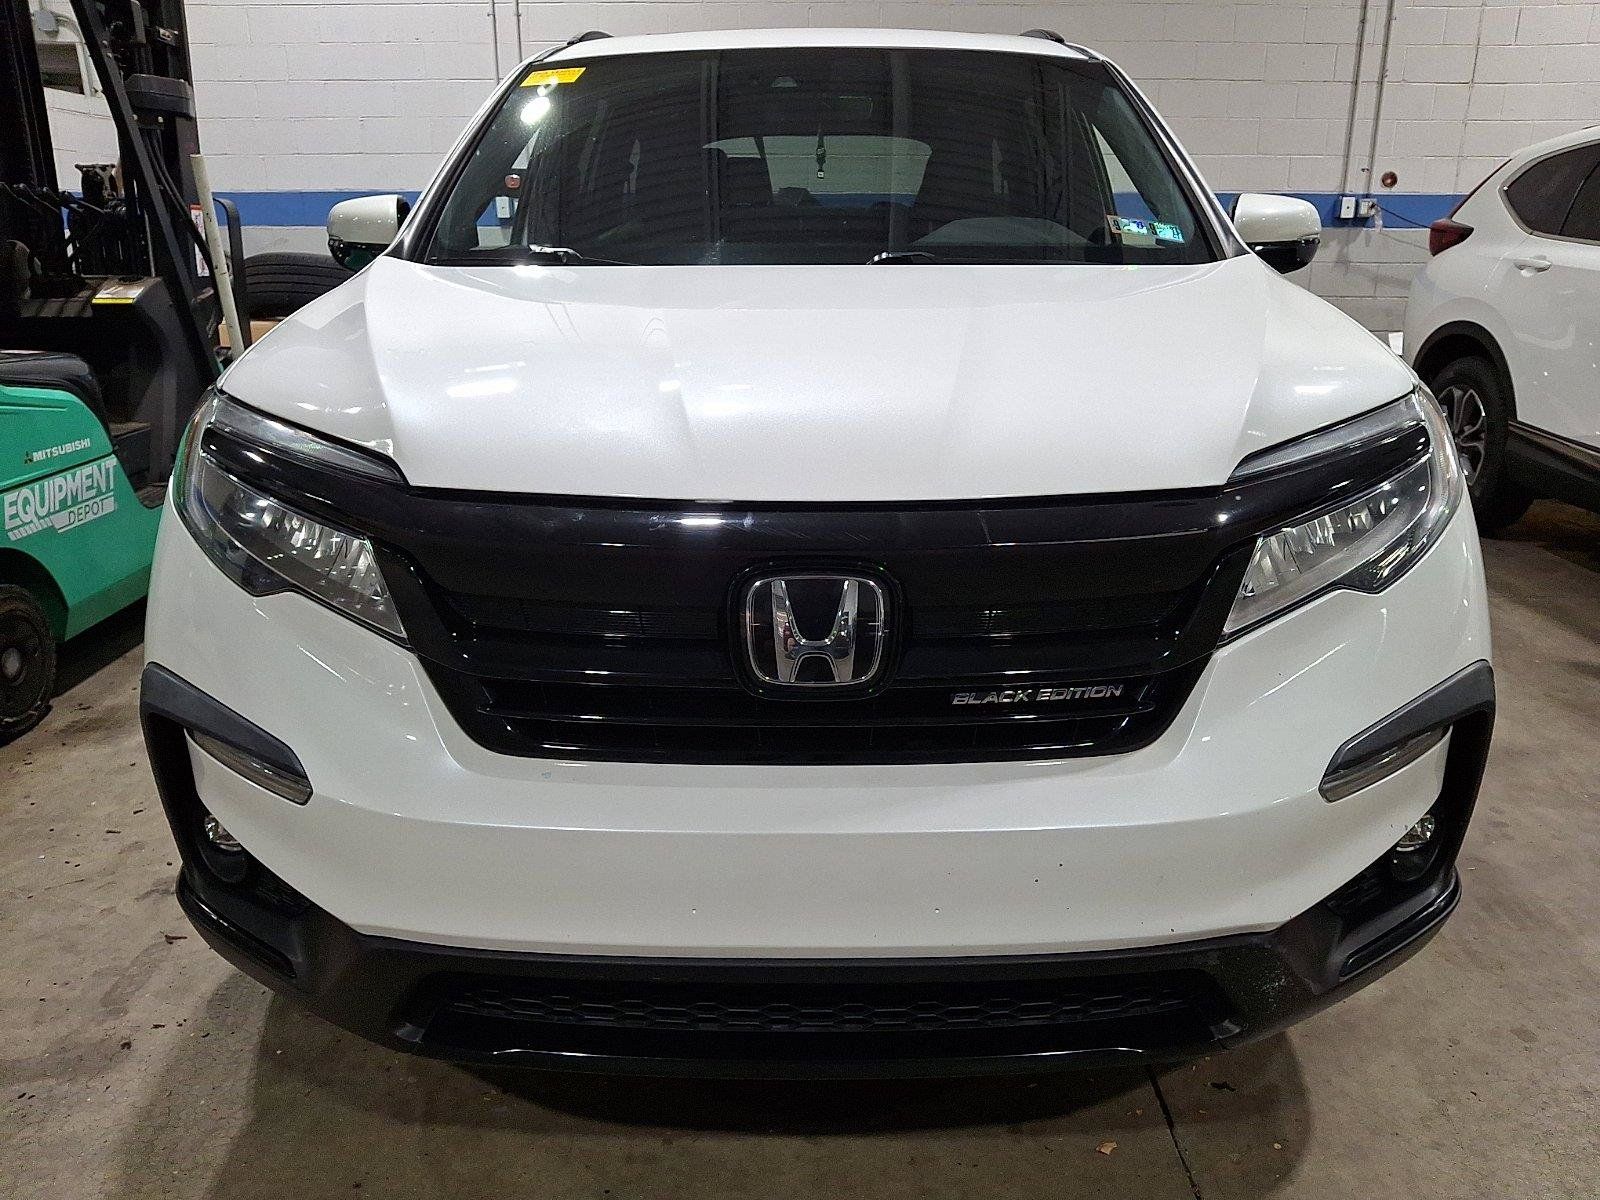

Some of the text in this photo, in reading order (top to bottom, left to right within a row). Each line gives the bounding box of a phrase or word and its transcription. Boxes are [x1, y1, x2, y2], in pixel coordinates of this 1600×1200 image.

[33, 438, 91, 462] MITSUBISHI
[4, 460, 117, 530] EQUIPMENT
[68, 500, 105, 524] DEPOT
[952, 684, 1124, 705] BLACK EDITION
